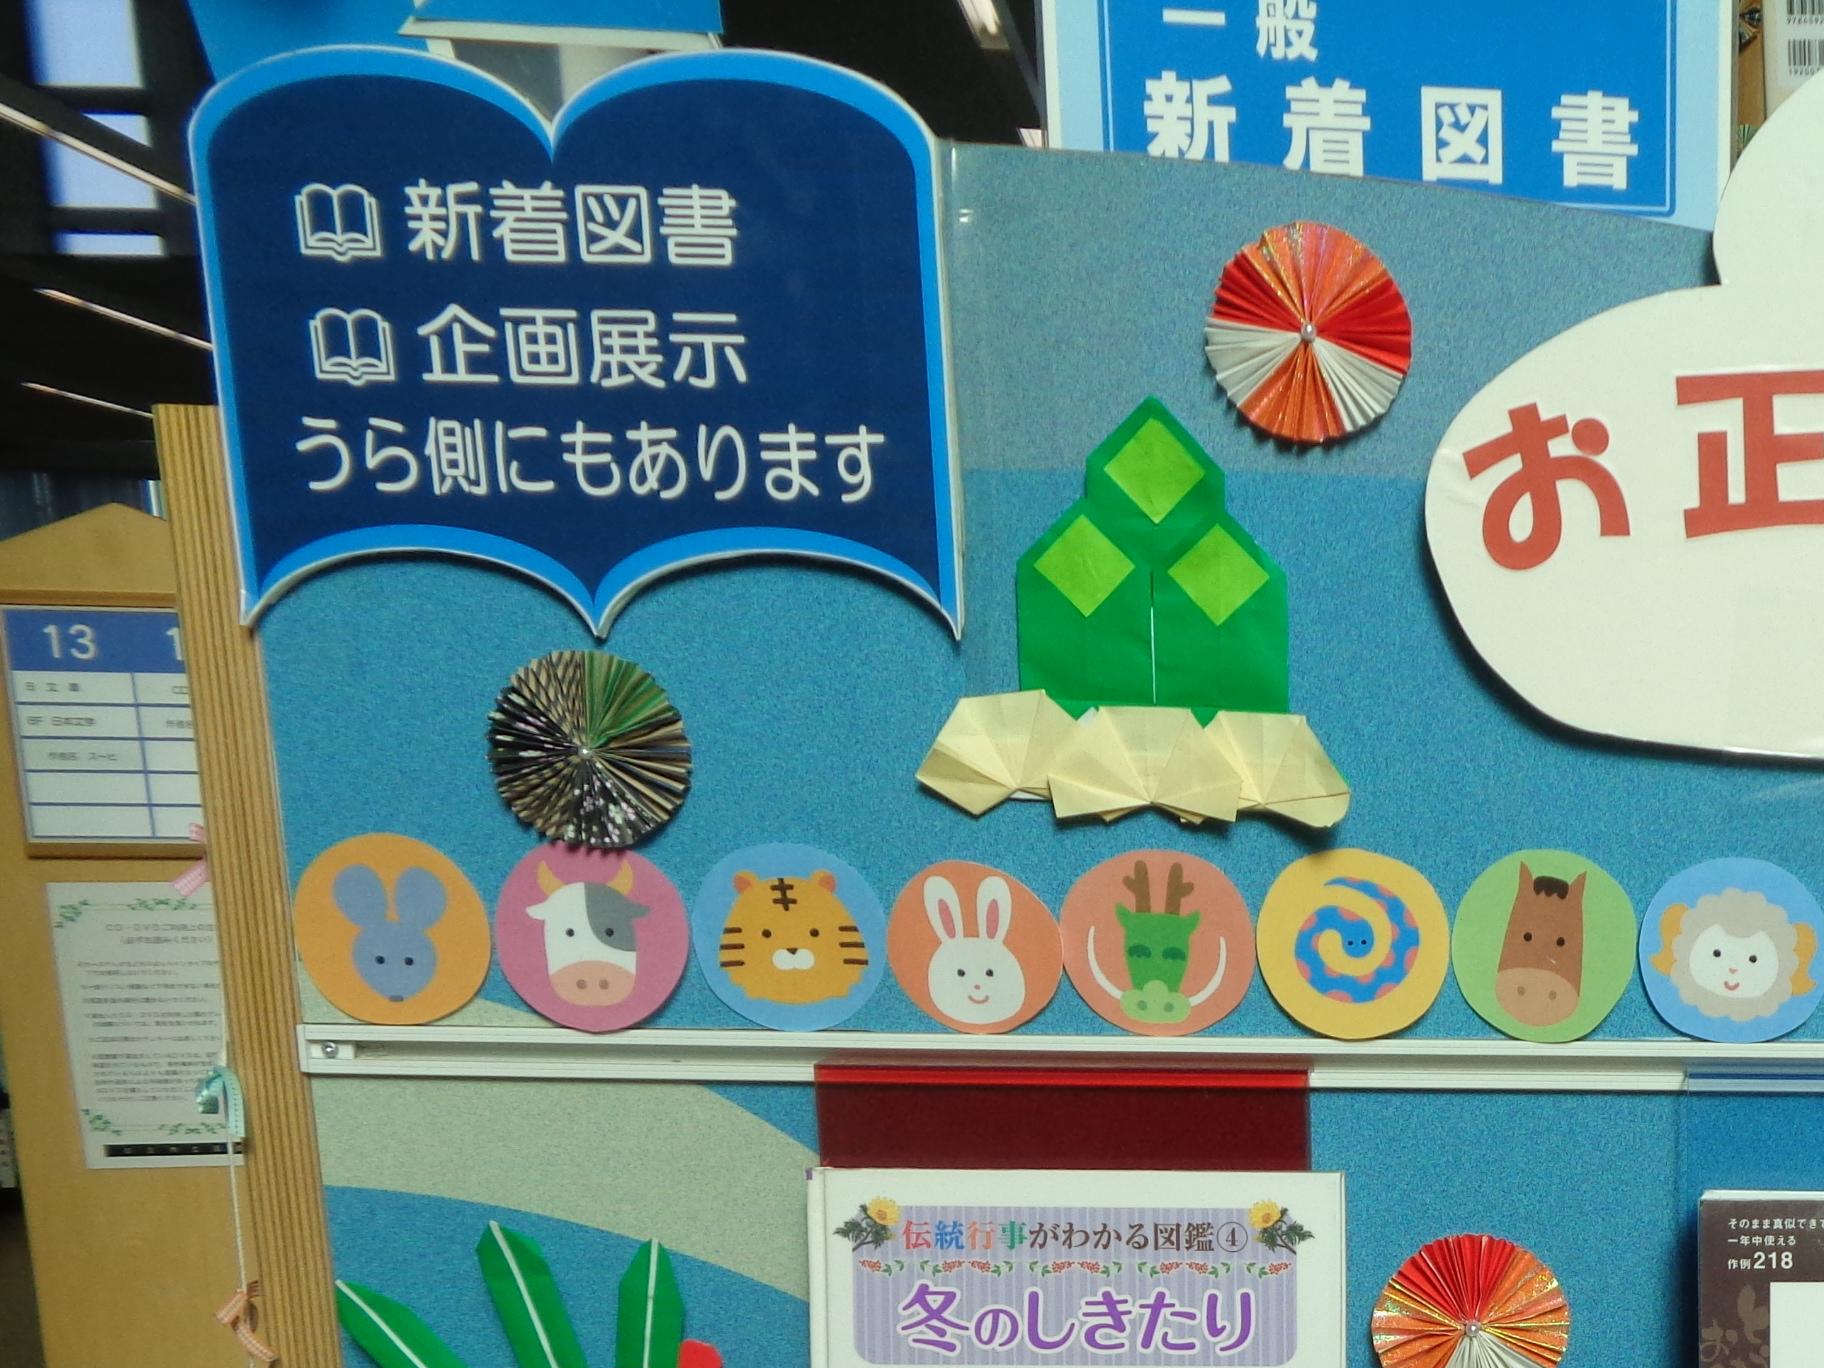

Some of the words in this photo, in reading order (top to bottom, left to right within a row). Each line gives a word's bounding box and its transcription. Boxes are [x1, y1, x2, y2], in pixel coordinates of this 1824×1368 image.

[1163, 0, 1318, 61] 一般
[1143, 71, 1640, 191] 新着図書
[405, 178, 738, 267] 新着図書
[418, 304, 748, 388] 企画展示
[295, 416, 885, 502] うら側にもあります
[43, 624, 97, 660] 13
[1727, 1235, 1797, 1247] 一年中使える
[1727, 1258, 1751, 1270] 作例
[1752, 1251, 1794, 1270] 218
[900, 1283, 1253, 1352] 冬のしきたり
